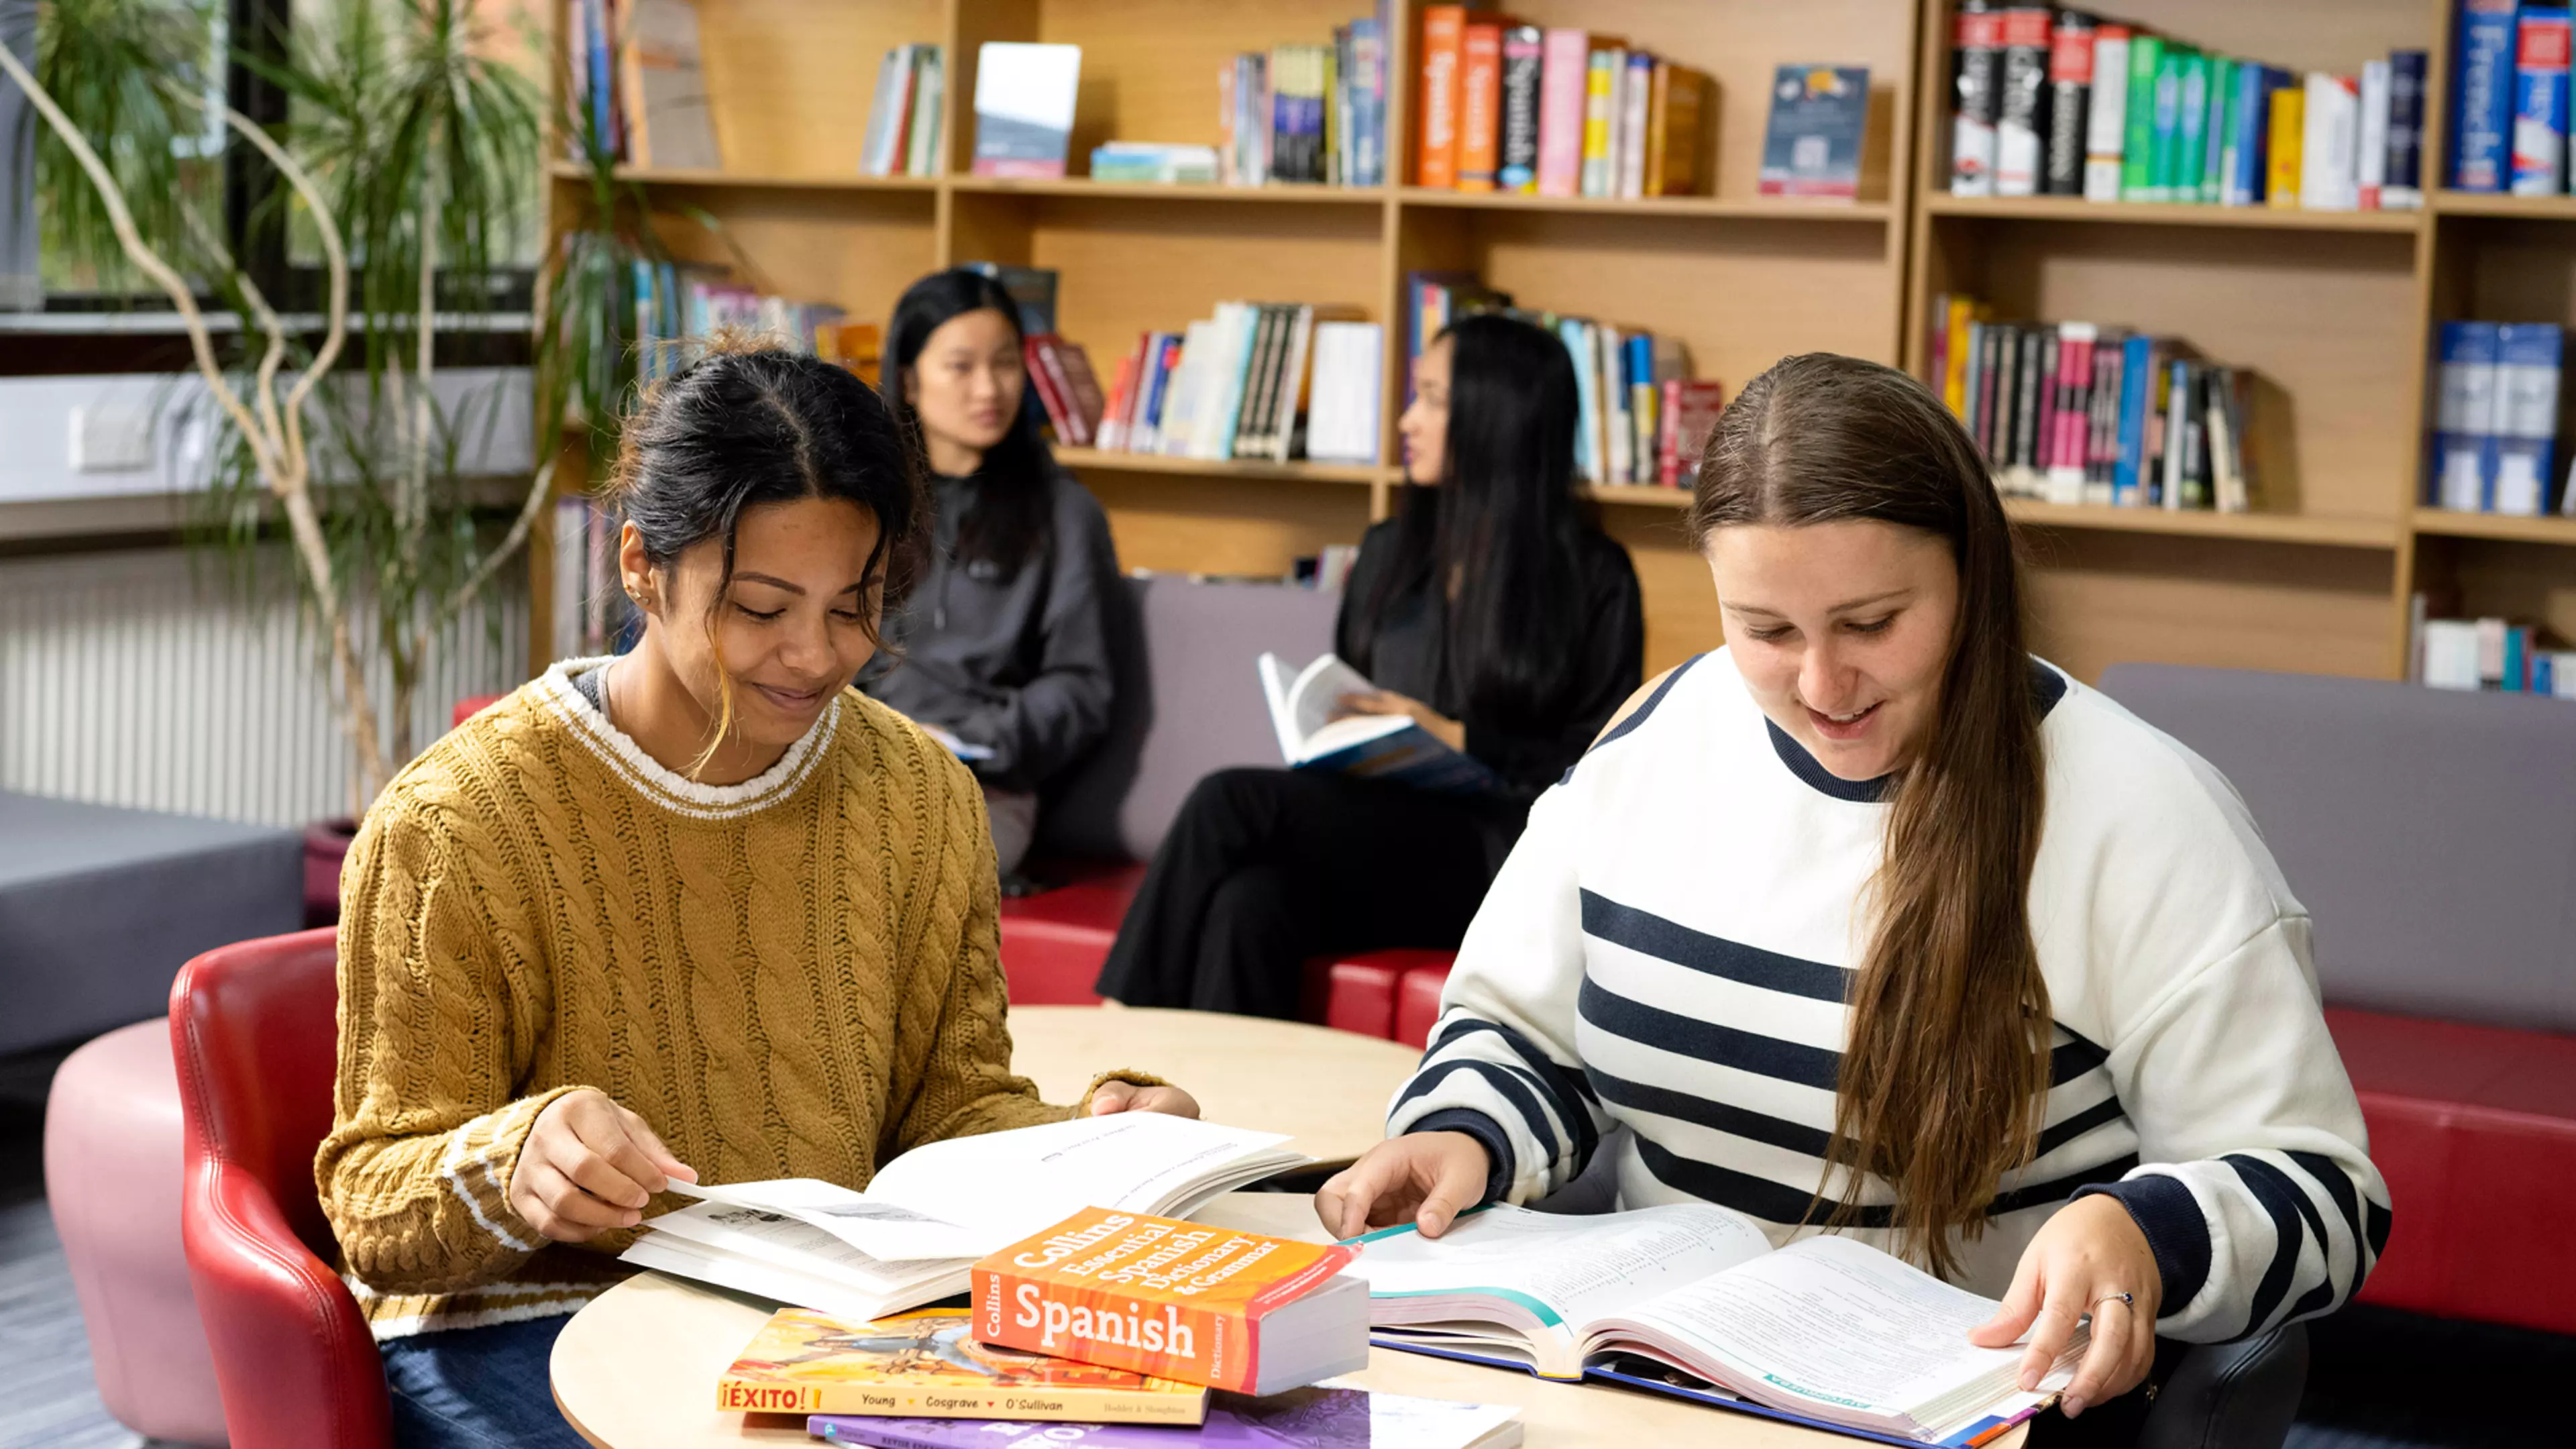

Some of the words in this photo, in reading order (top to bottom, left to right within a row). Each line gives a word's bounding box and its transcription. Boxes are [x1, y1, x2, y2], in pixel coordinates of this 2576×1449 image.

[1014, 1214, 1134, 1269] Collins
[1060, 1224, 1176, 1278] Essential
[1098, 1228, 1218, 1284] Spanish
[1140, 1236, 1256, 1291] Dictionary
[986, 1275, 1000, 1338] Collins
[1015, 1284, 1195, 1359] Spanish
[1210, 1314, 1227, 1380] Dictionary
[722, 1381, 805, 1410] ¡ÉXITO!
[862, 1394, 896, 1407] Young
[926, 1396, 978, 1410] Cosgrave
[1006, 1398, 1063, 1411] O'Sullivan
